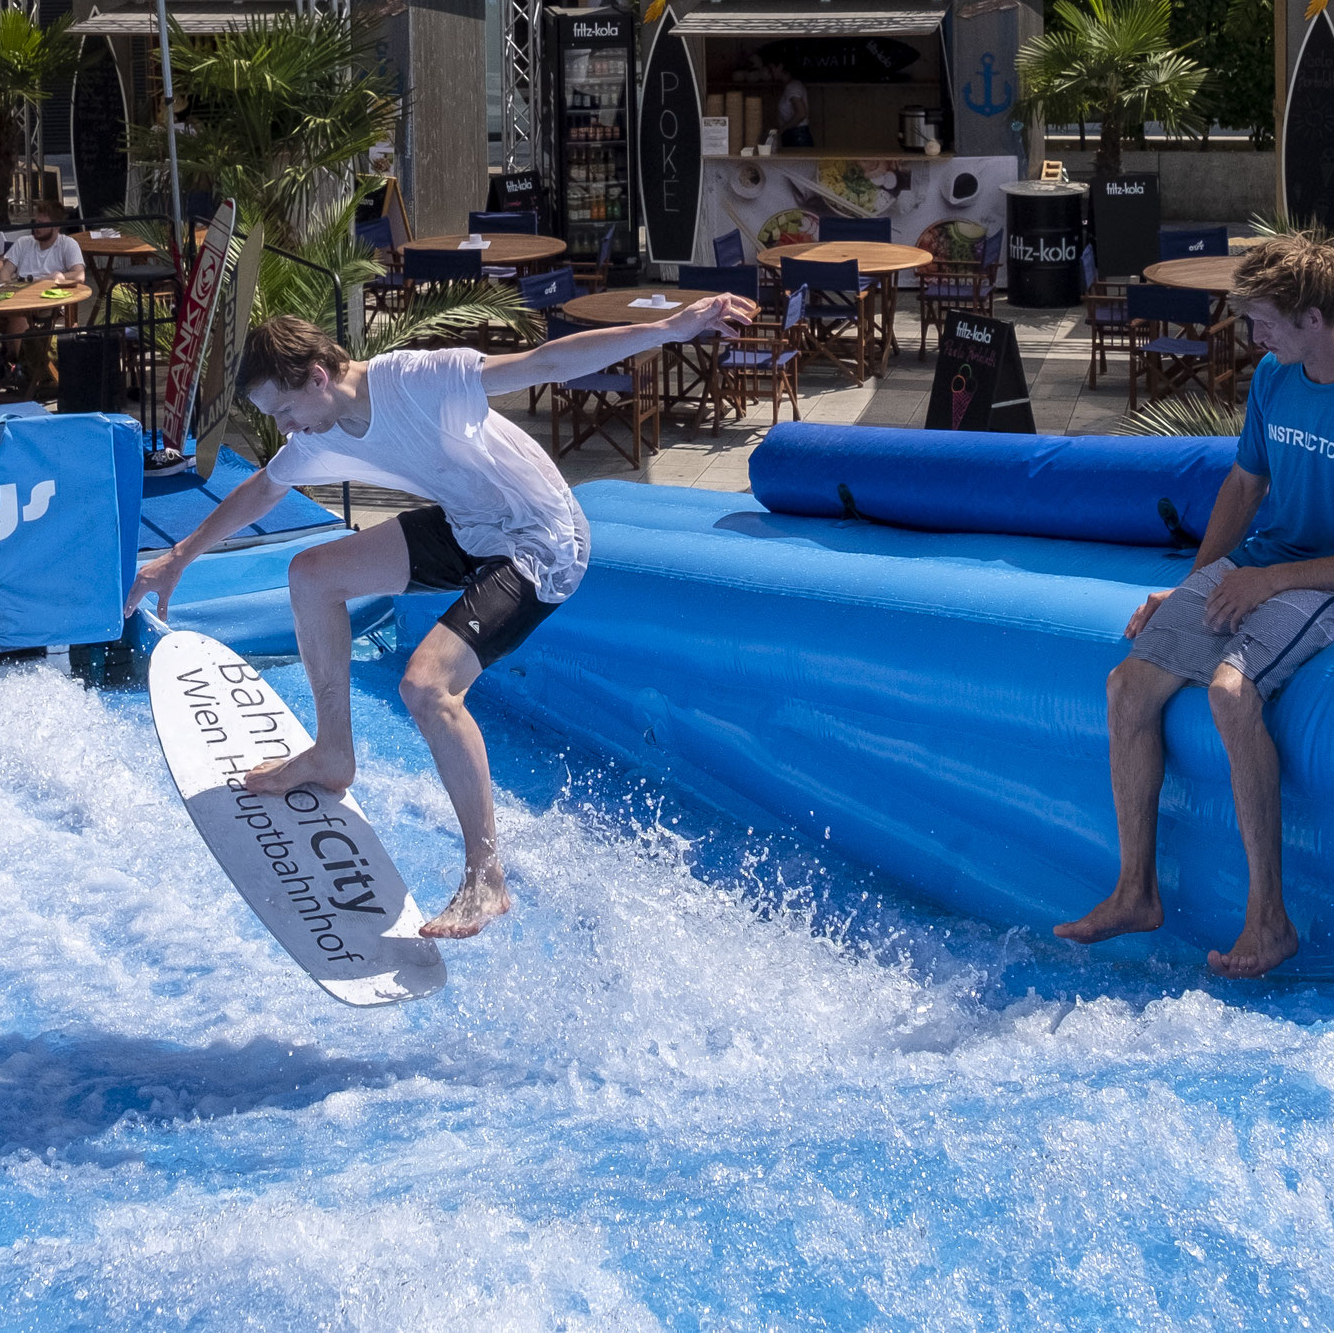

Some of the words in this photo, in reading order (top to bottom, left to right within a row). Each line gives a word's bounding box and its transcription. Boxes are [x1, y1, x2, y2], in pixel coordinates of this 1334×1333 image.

[572, 21, 619, 38] fritz-kola
[1106, 181, 1145, 195] fritz-kola
[1009, 234, 1077, 262] fritz-kola
[955, 320, 992, 344] fritz-kola
[218, 662, 387, 915] BahnofCity
[176, 667, 228, 745] Wien
[214, 754, 365, 963] Hauptbahnhof
